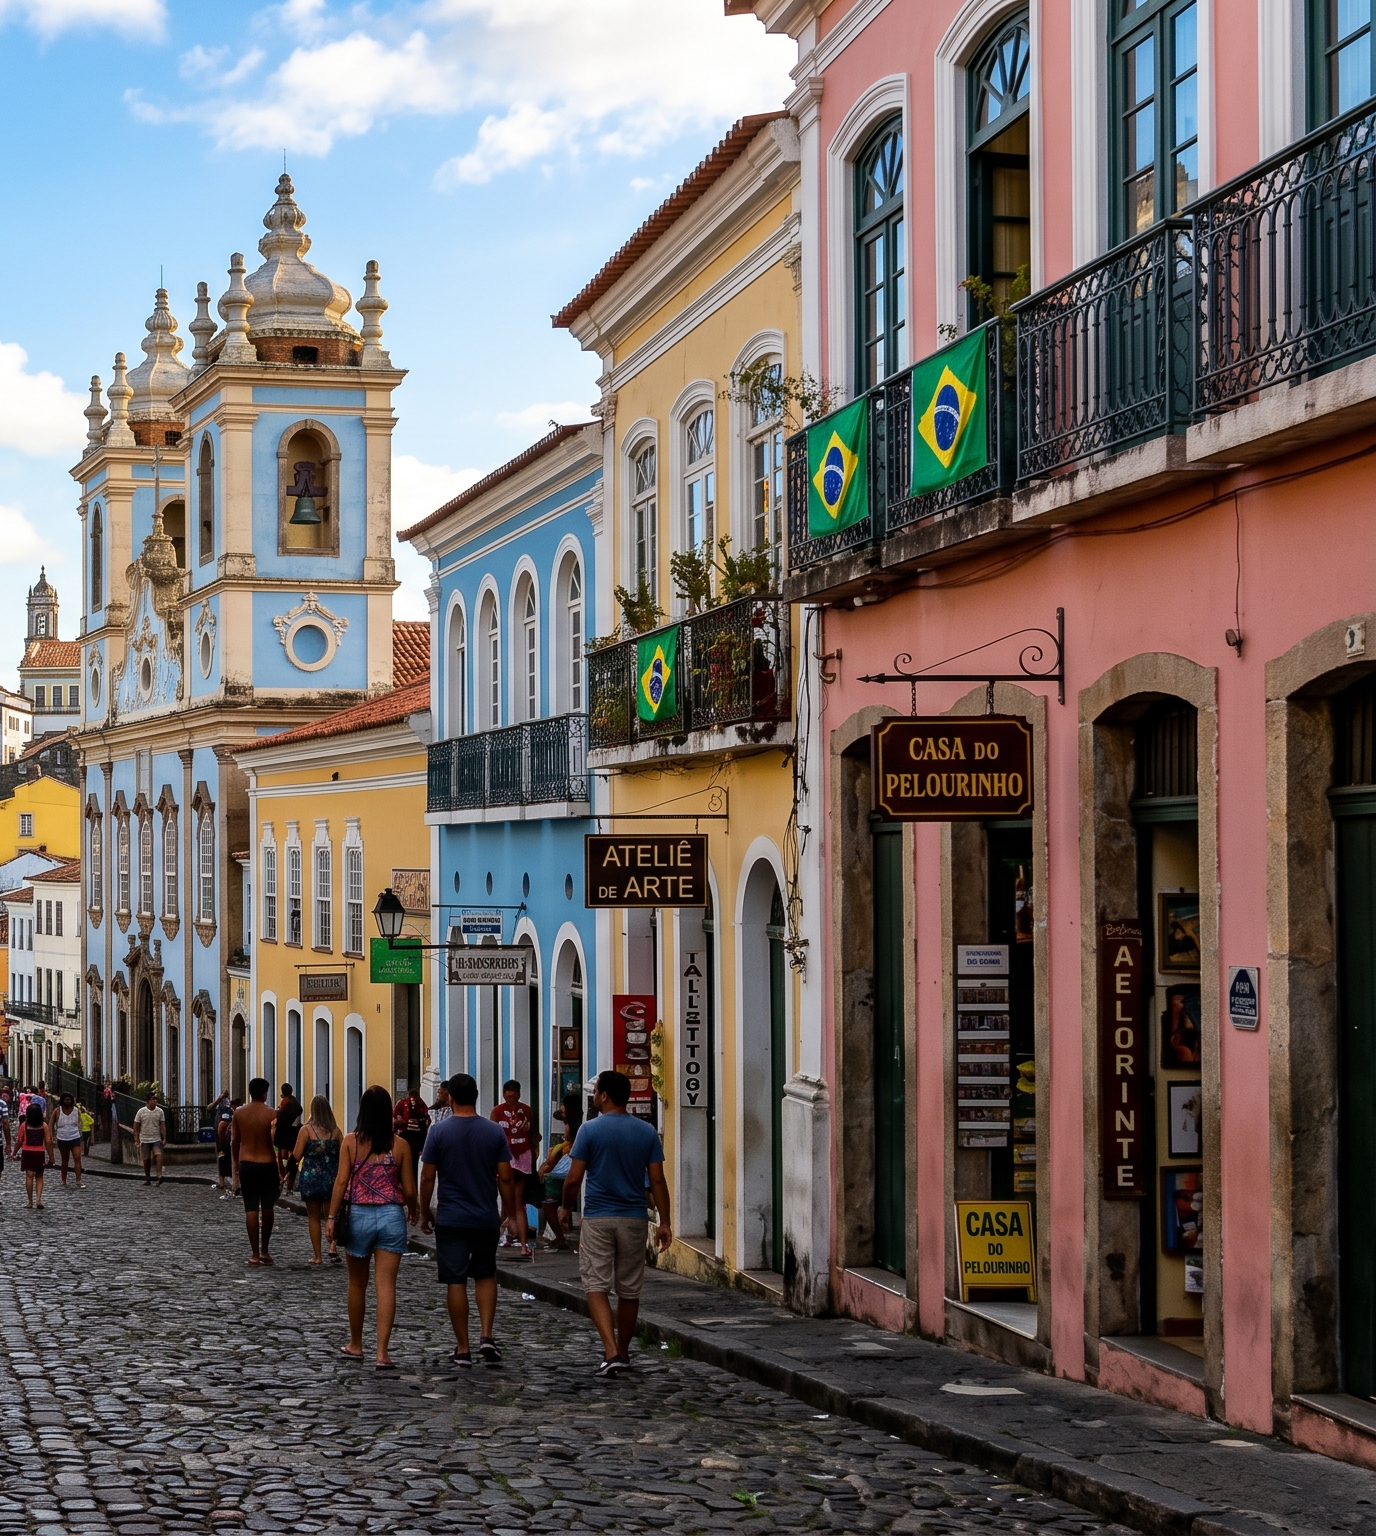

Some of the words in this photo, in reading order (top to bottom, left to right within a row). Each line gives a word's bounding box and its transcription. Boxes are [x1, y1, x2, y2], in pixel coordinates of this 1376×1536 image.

[909, 737, 966, 761] CASA
[974, 742, 999, 760] DO
[886, 773, 1023, 797] PELOURINHO
[602, 840, 692, 867] ATELIÊ
[598, 886, 618, 898] DE
[623, 876, 694, 898] ARTE
[1113, 945, 1135, 1187] AELORINTE
[966, 1211, 1024, 1237] CASA
[987, 1243, 1003, 1256] DO
